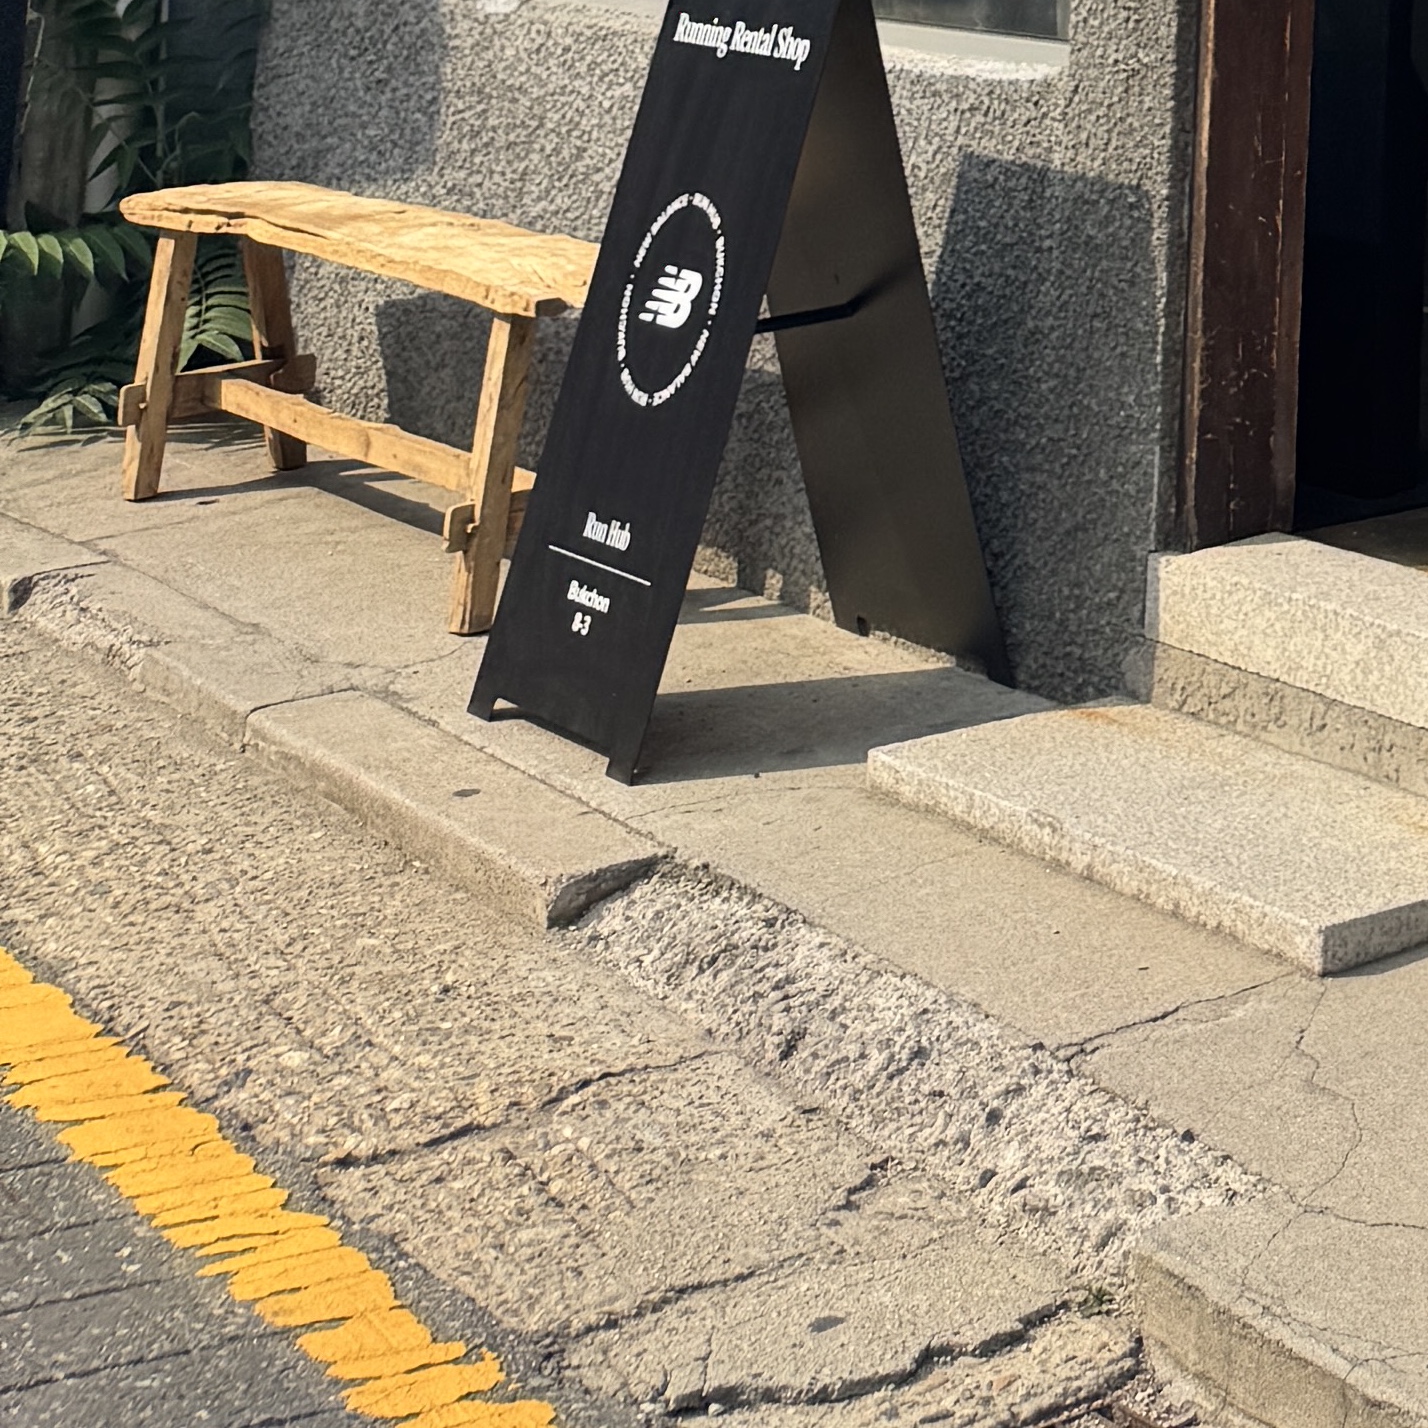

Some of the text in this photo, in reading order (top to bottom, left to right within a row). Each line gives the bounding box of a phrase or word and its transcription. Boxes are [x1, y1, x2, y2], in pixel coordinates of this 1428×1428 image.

[673, 12, 811, 71] Running Rental Shop
[582, 511, 631, 552] Run Hub
[566, 579, 611, 614] Bukchon
[571, 611, 592, 636] 8-3
